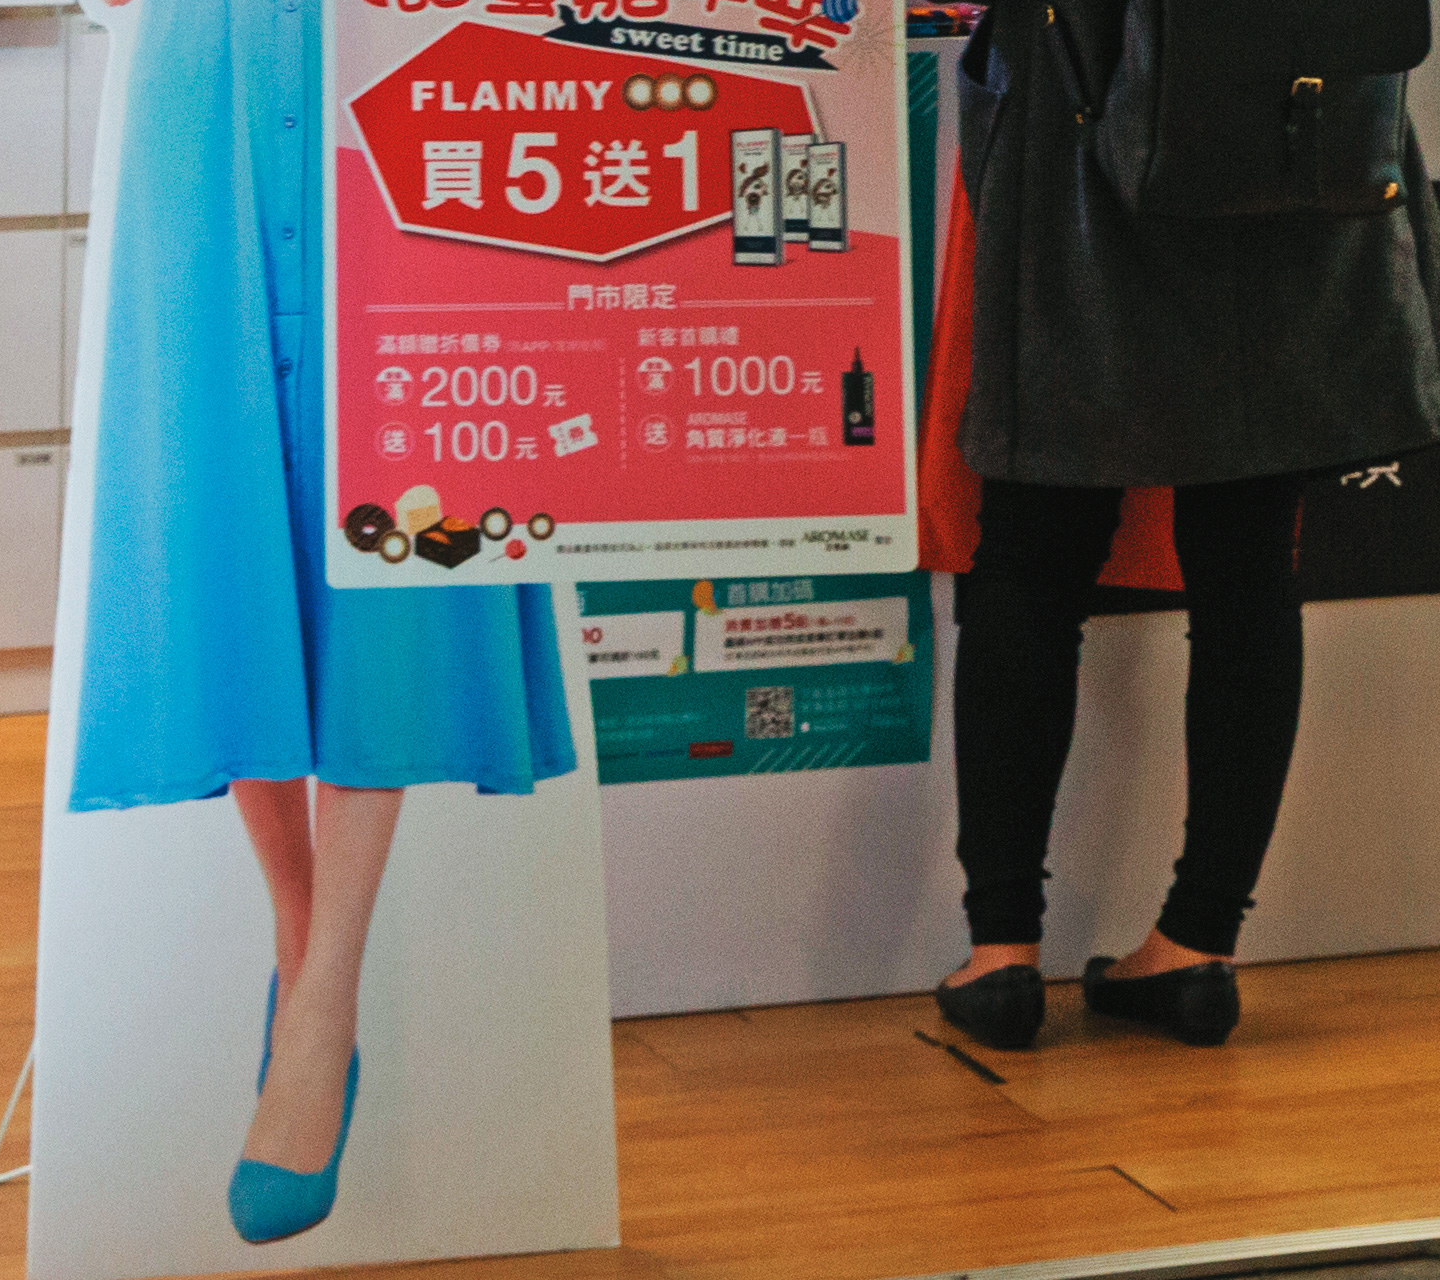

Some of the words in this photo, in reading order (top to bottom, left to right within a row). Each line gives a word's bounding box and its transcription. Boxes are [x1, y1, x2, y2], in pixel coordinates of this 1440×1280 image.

[609, 24, 703, 55] sweet
[712, 30, 785, 63] time
[410, 79, 614, 112] FLANMY
[566, 283, 678, 311] 門市限定
